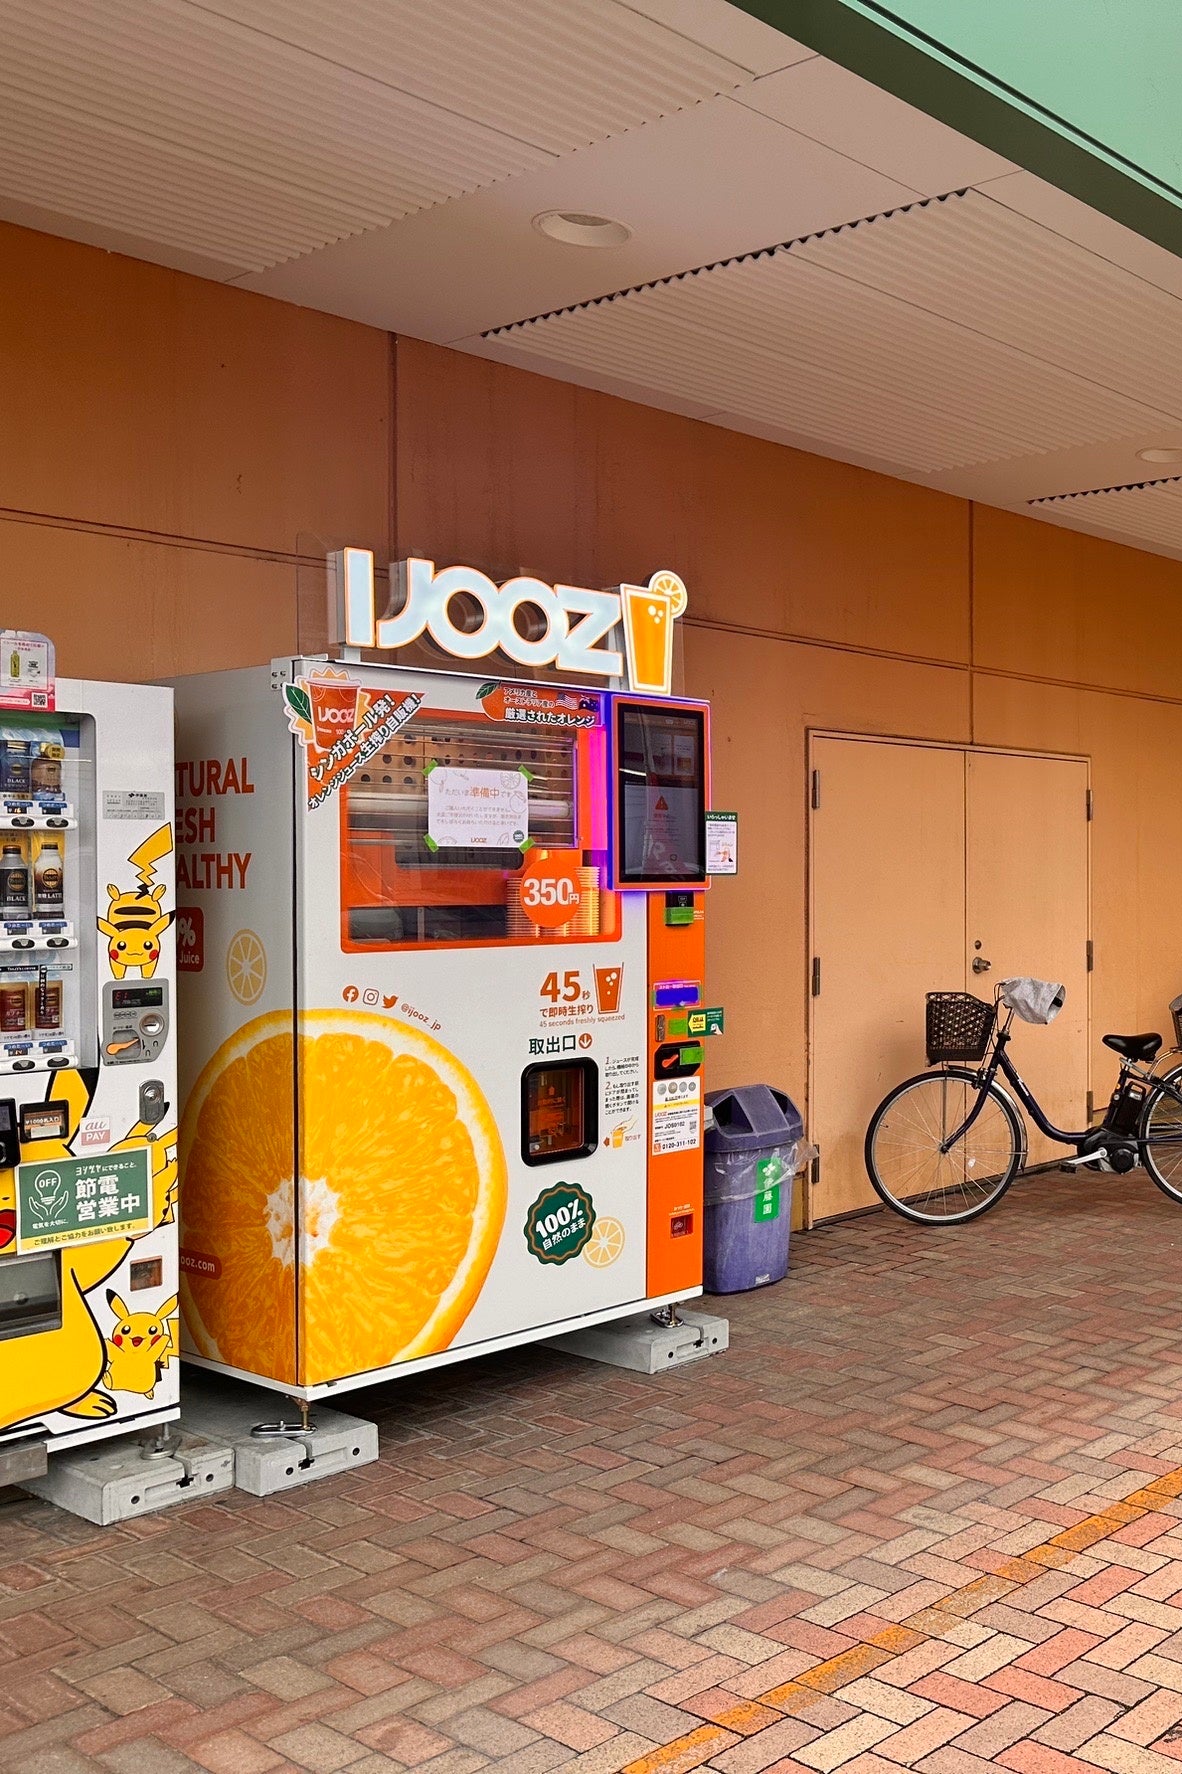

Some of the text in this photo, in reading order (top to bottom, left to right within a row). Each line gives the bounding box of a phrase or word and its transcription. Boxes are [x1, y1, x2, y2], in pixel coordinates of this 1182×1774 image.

[174, 757, 255, 797] TURAL
[524, 878, 580, 906] 350円
[179, 951, 200, 965] Juice
[400, 1002, 442, 1032] @ijooz_jp
[539, 1004, 594, 1018] で即時生搾り
[548, 1018, 574, 1027] seconds
[528, 1034, 577, 1056] 取出口
[86, 1131, 106, 1142] PAY
[39, 1177, 57, 1189] OFF
[75, 1174, 119, 1200] 節電
[76, 1193, 141, 1222] 営業中
[536, 1198, 583, 1238] 100%
[542, 1217, 586, 1251] 自然のまま
